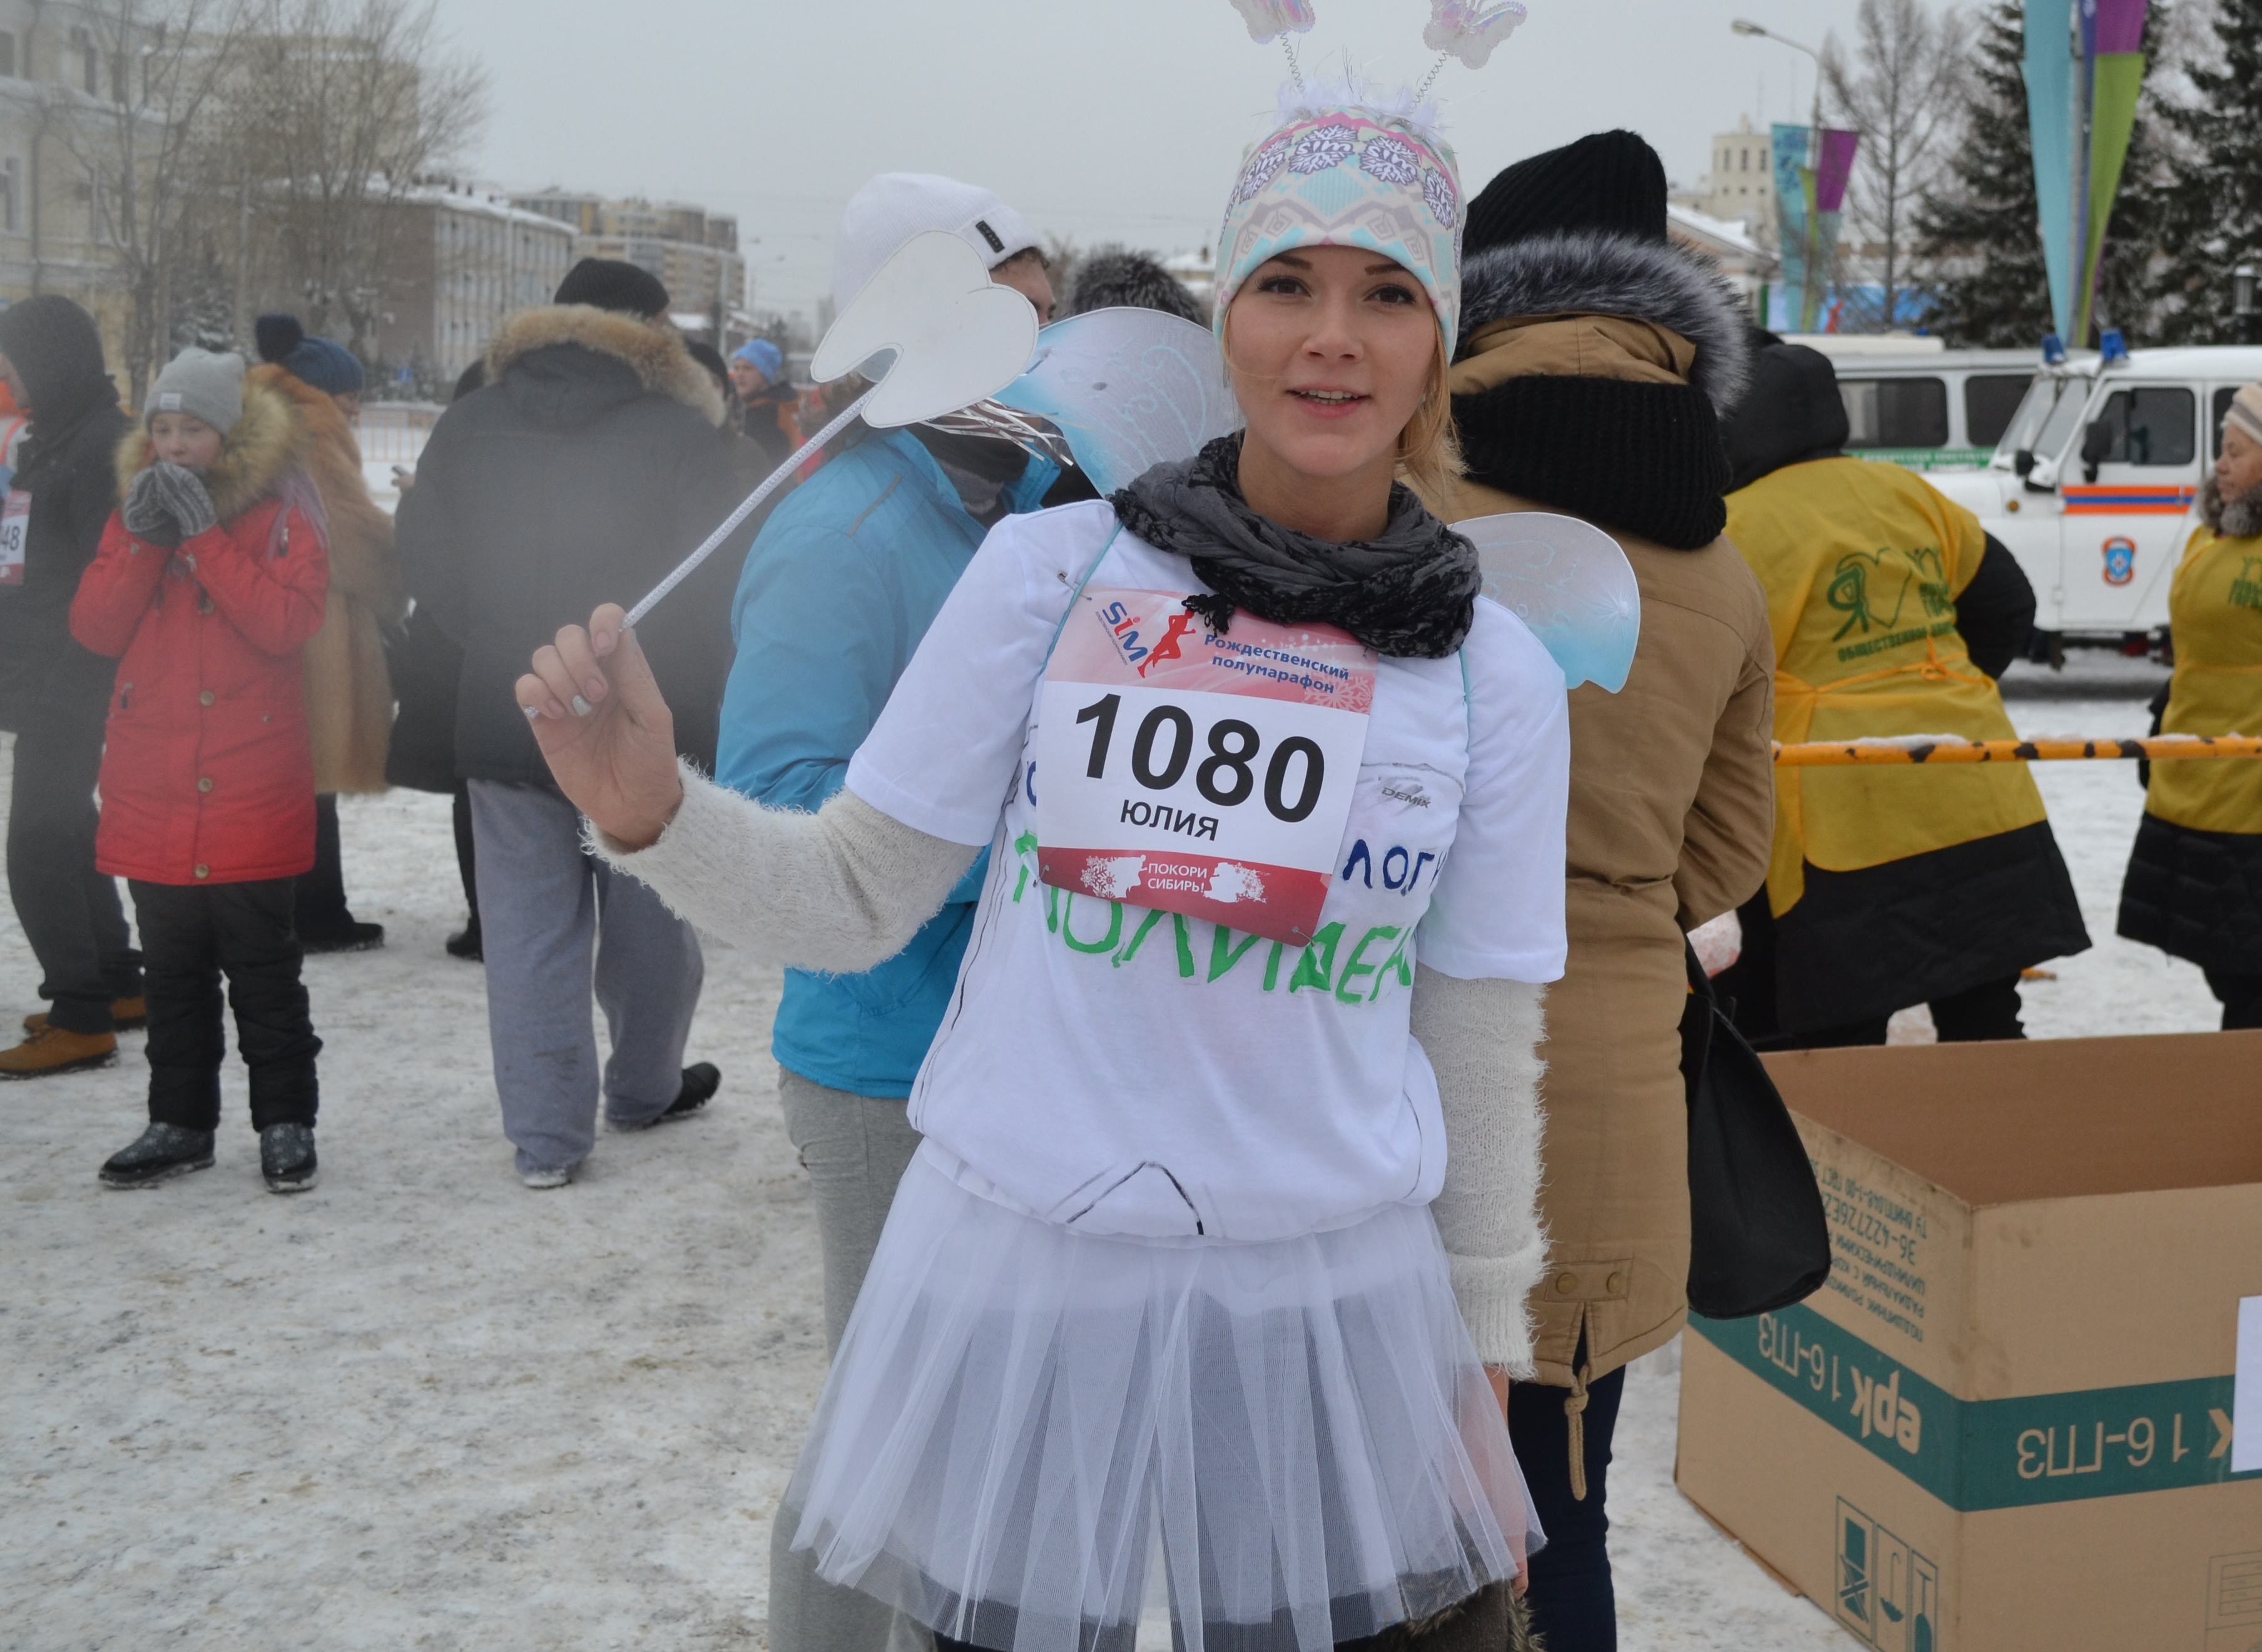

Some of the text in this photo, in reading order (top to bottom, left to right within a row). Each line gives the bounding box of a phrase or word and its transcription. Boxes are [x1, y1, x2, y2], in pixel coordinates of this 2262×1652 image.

[1205, 634, 1350, 681] Рождественский
[1212, 656, 1335, 694] полумарафон
[1075, 693, 1325, 823] 1080
[1381, 787, 1432, 808] DEMIX
[1120, 799, 1219, 841] ЮЛИЯ
[1148, 863, 1208, 879] ПОКОРИ
[1148, 878, 1205, 893] СИБИРЬ!
[1850, 1365, 1922, 1455] epk
